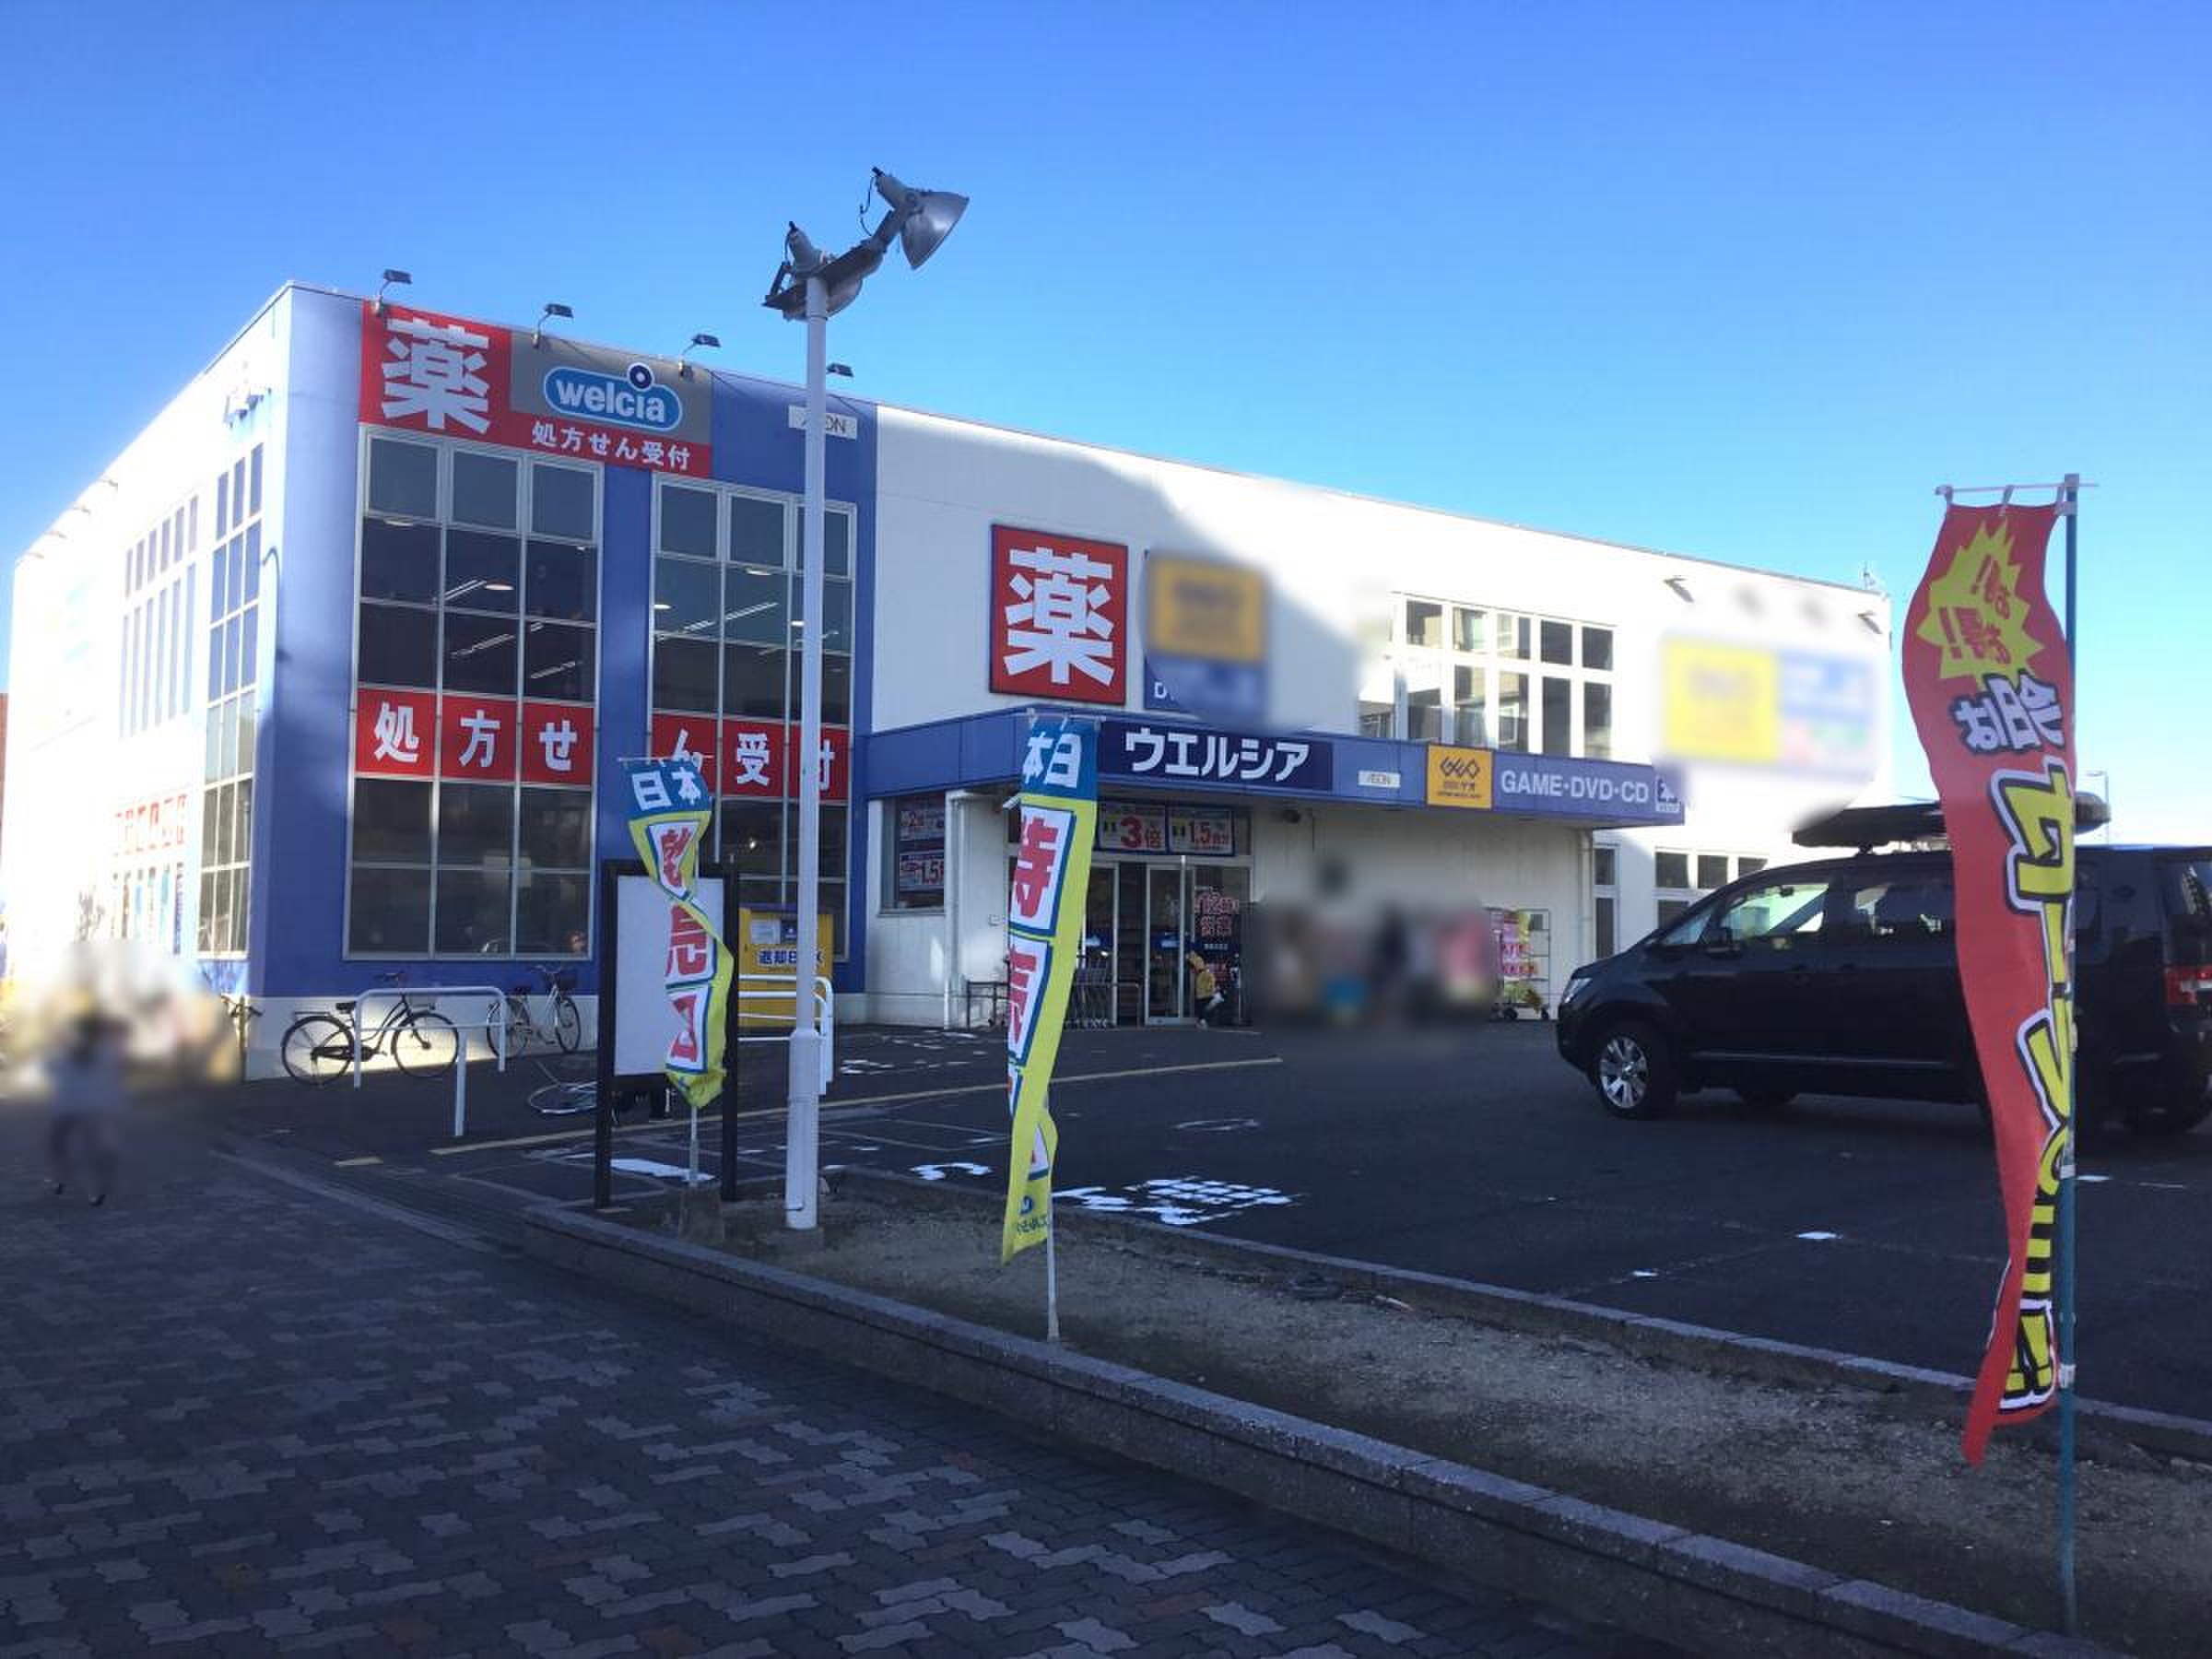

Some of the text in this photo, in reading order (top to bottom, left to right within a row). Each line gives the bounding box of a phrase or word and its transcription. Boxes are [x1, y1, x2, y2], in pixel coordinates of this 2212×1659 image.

[381, 316, 490, 433] 薬
[555, 369, 665, 424] welcia
[532, 420, 691, 471] 処方せん受付
[1003, 547, 1114, 687] 薬
[1124, 726, 1311, 782] ウエルシア
